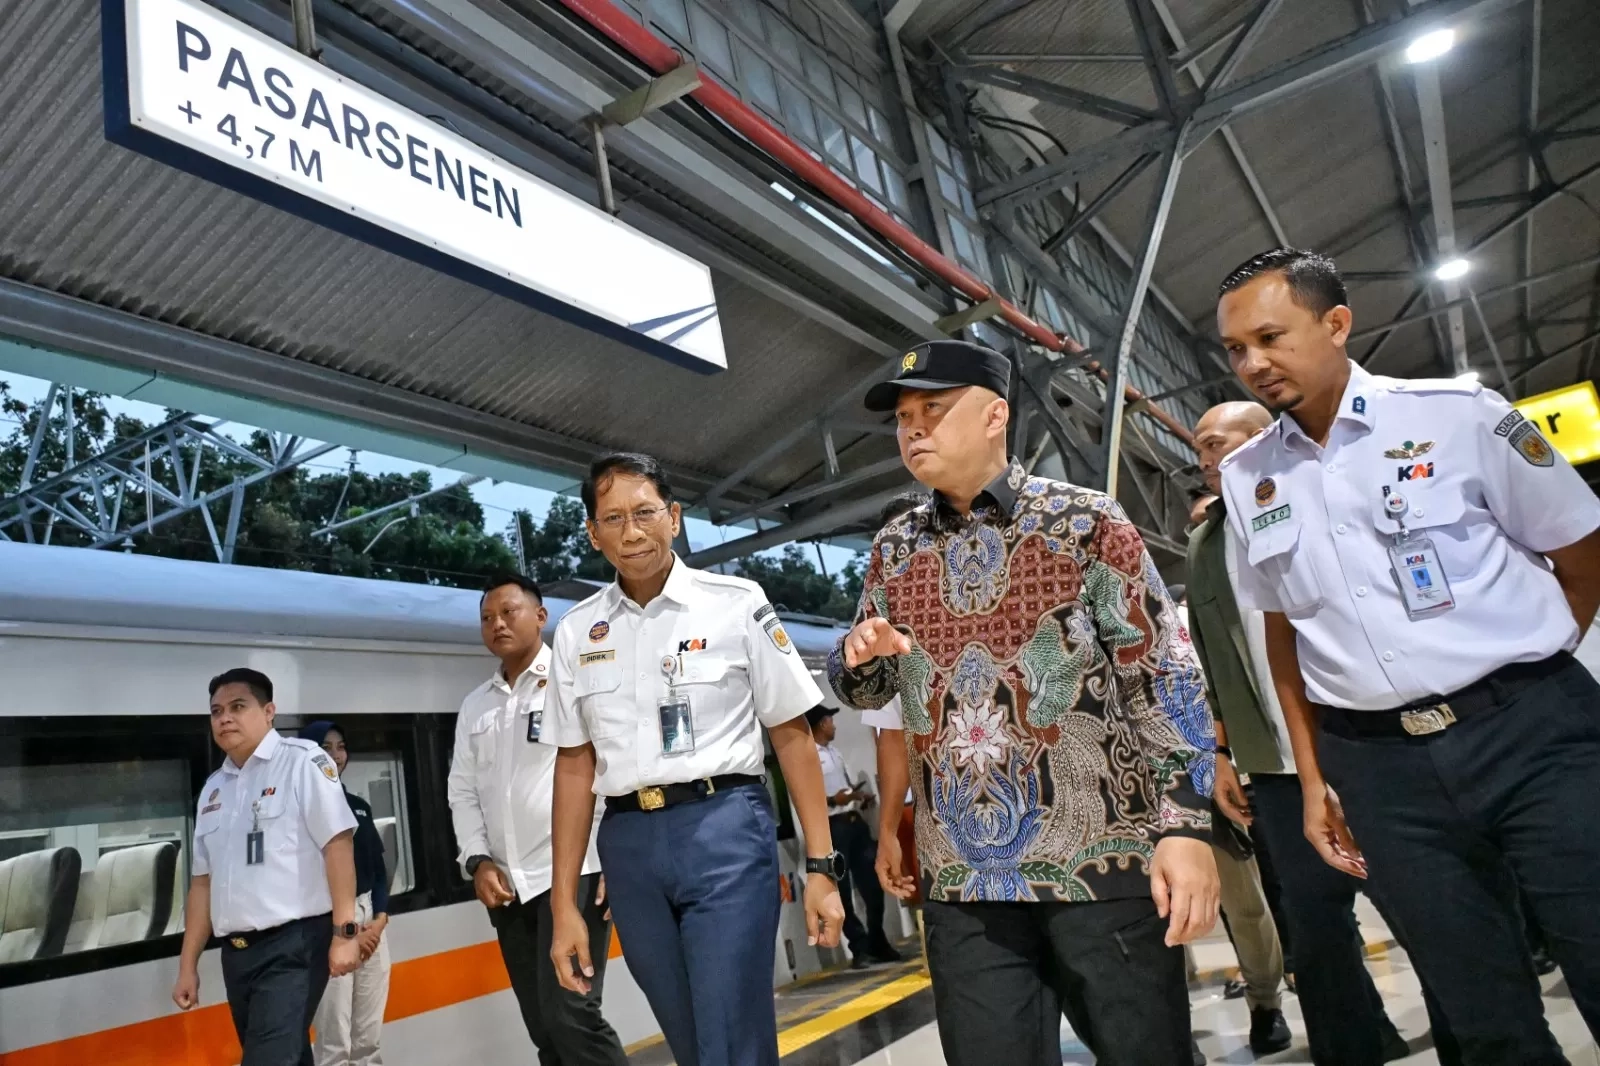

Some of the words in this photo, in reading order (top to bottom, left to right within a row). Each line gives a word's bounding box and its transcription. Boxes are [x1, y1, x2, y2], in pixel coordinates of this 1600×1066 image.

[176, 20, 523, 228] PASARSENEN
[216, 113, 276, 160] 4,7
[290, 139, 323, 182] M
[1397, 461, 1434, 482] KAI
[1406, 554, 1425, 565] KAI
[678, 638, 707, 653] KAI
